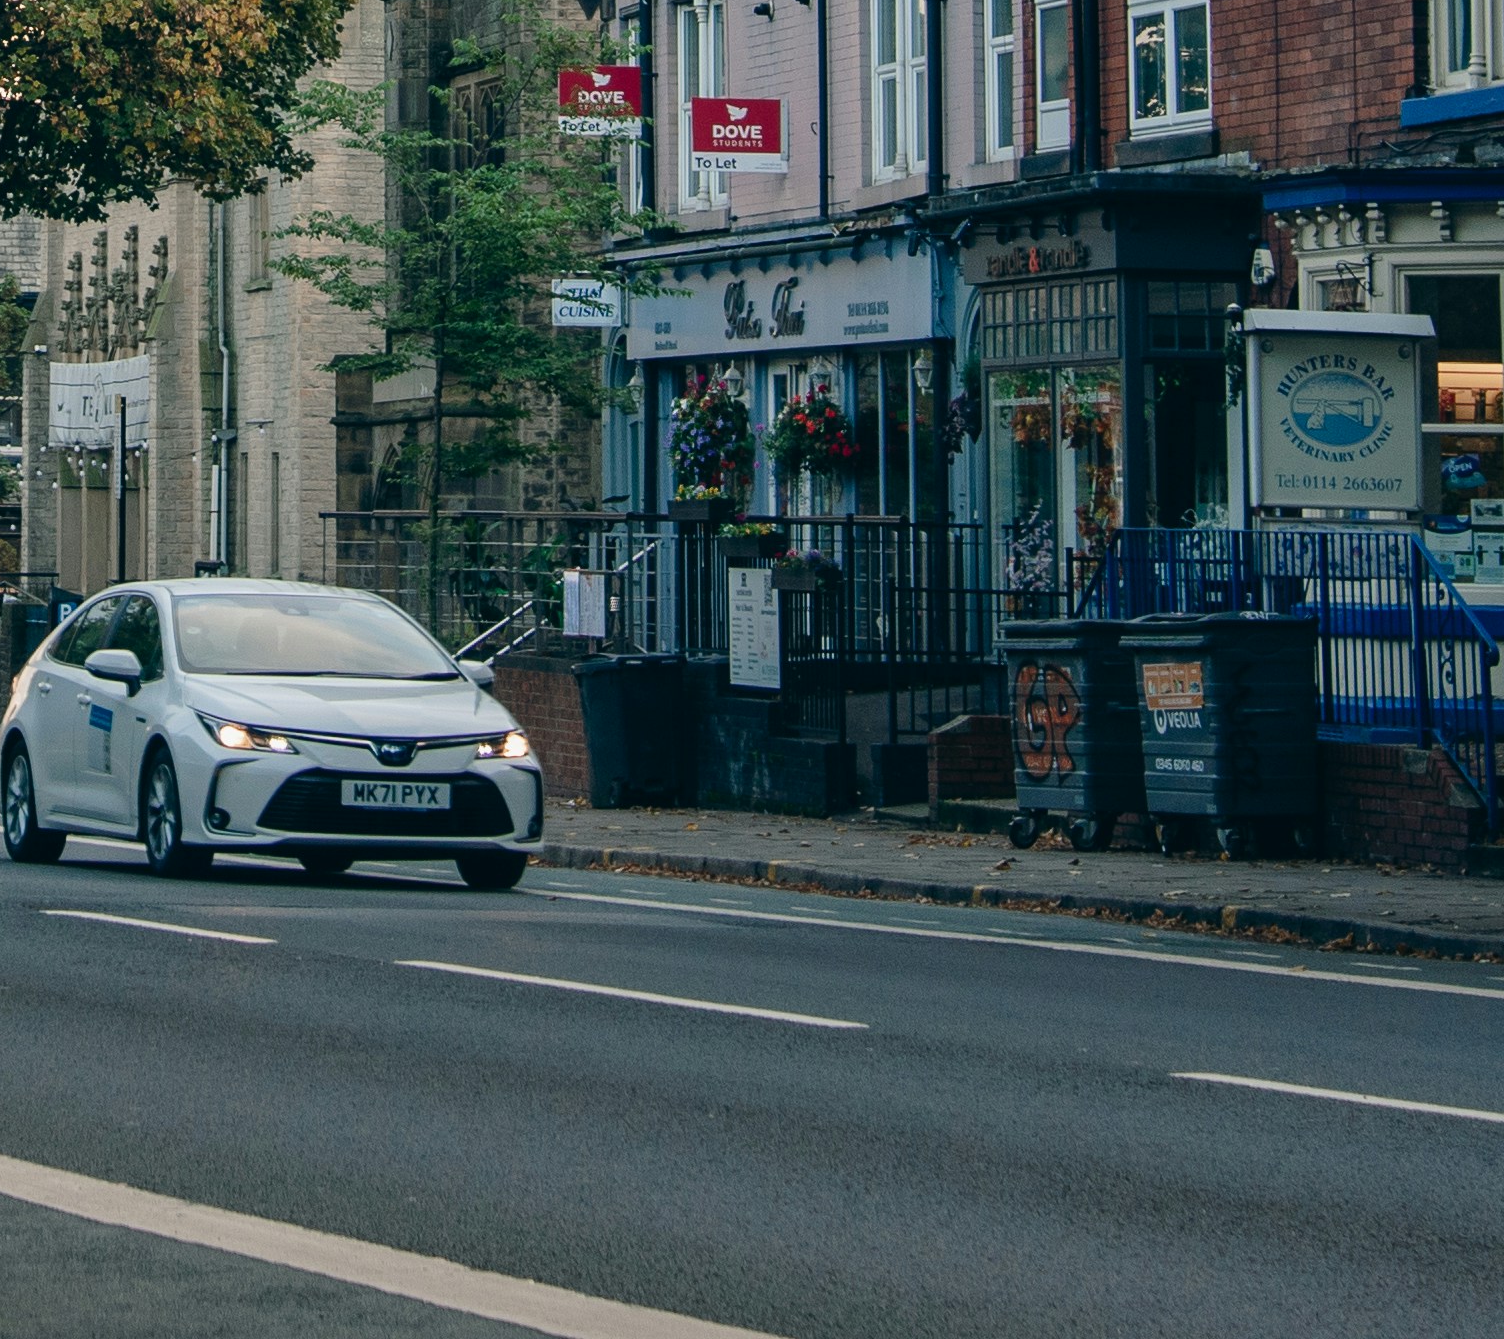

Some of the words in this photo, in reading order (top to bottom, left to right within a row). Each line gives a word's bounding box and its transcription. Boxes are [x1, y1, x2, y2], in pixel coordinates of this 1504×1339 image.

[578, 91, 625, 104] DOVE
[712, 125, 762, 139] DOVE
[712, 139, 763, 148] STUDENTS
[695, 157, 712, 169] To
[716, 157, 737, 169] Let
[559, 305, 615, 318] CUISINE
[1277, 354, 1358, 397] HUNTERS
[1362, 364, 1395, 401] BAR
[1280, 418, 1355, 463] VETERINARY
[1359, 421, 1394, 459] CLINIC
[1448, 462, 1473, 473] OPEN
[1275, 474, 1300, 488] Tel:
[1303, 475, 1336, 489] 0114
[1343, 476, 1402, 492] 2663607
[60, 603, 72, 622] P
[1167, 711, 1202, 729] VEOLIA
[354, 783, 396, 803] MK71
[401, 785, 439, 804] PYX
